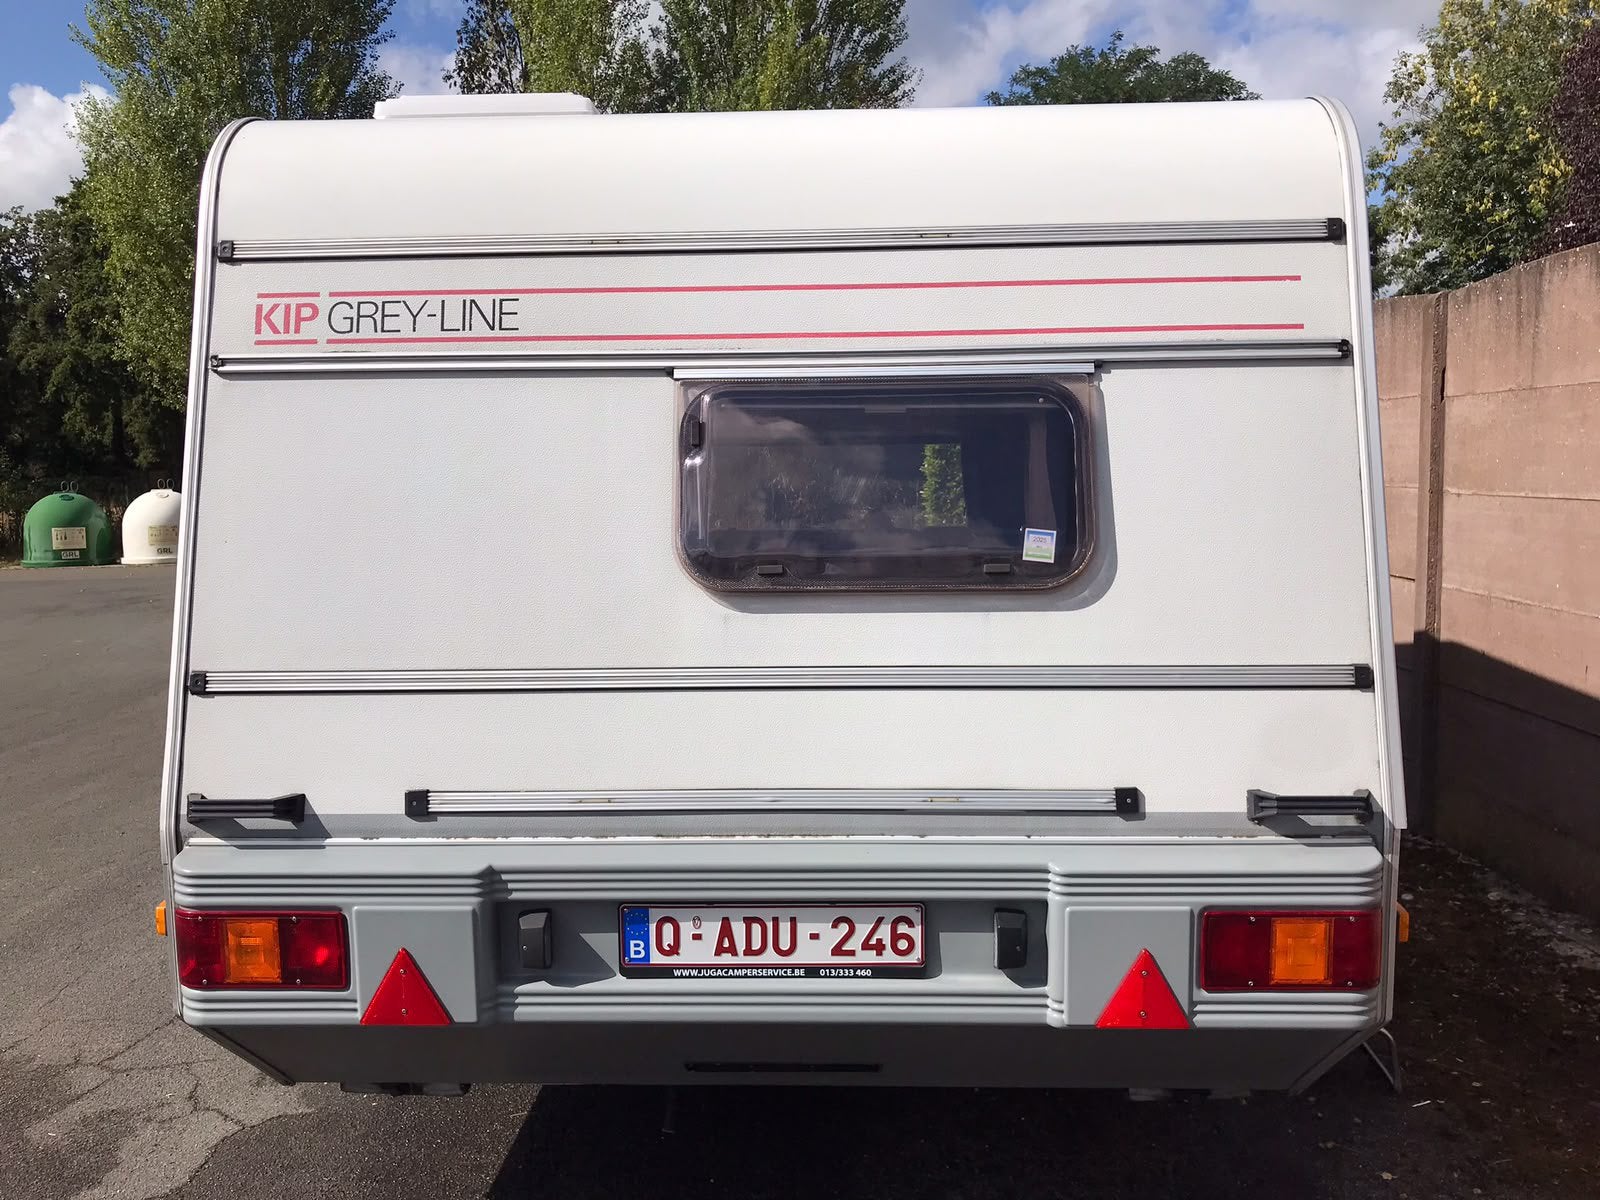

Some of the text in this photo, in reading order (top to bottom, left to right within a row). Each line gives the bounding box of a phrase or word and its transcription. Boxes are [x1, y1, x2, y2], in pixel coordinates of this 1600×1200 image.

[254, 298, 520, 335] KIP GREY-LINE
[629, 940, 646, 959] B
[673, 968, 872, 977] WWW.JUGACAMPERSERVICE.BE 013/333 460
